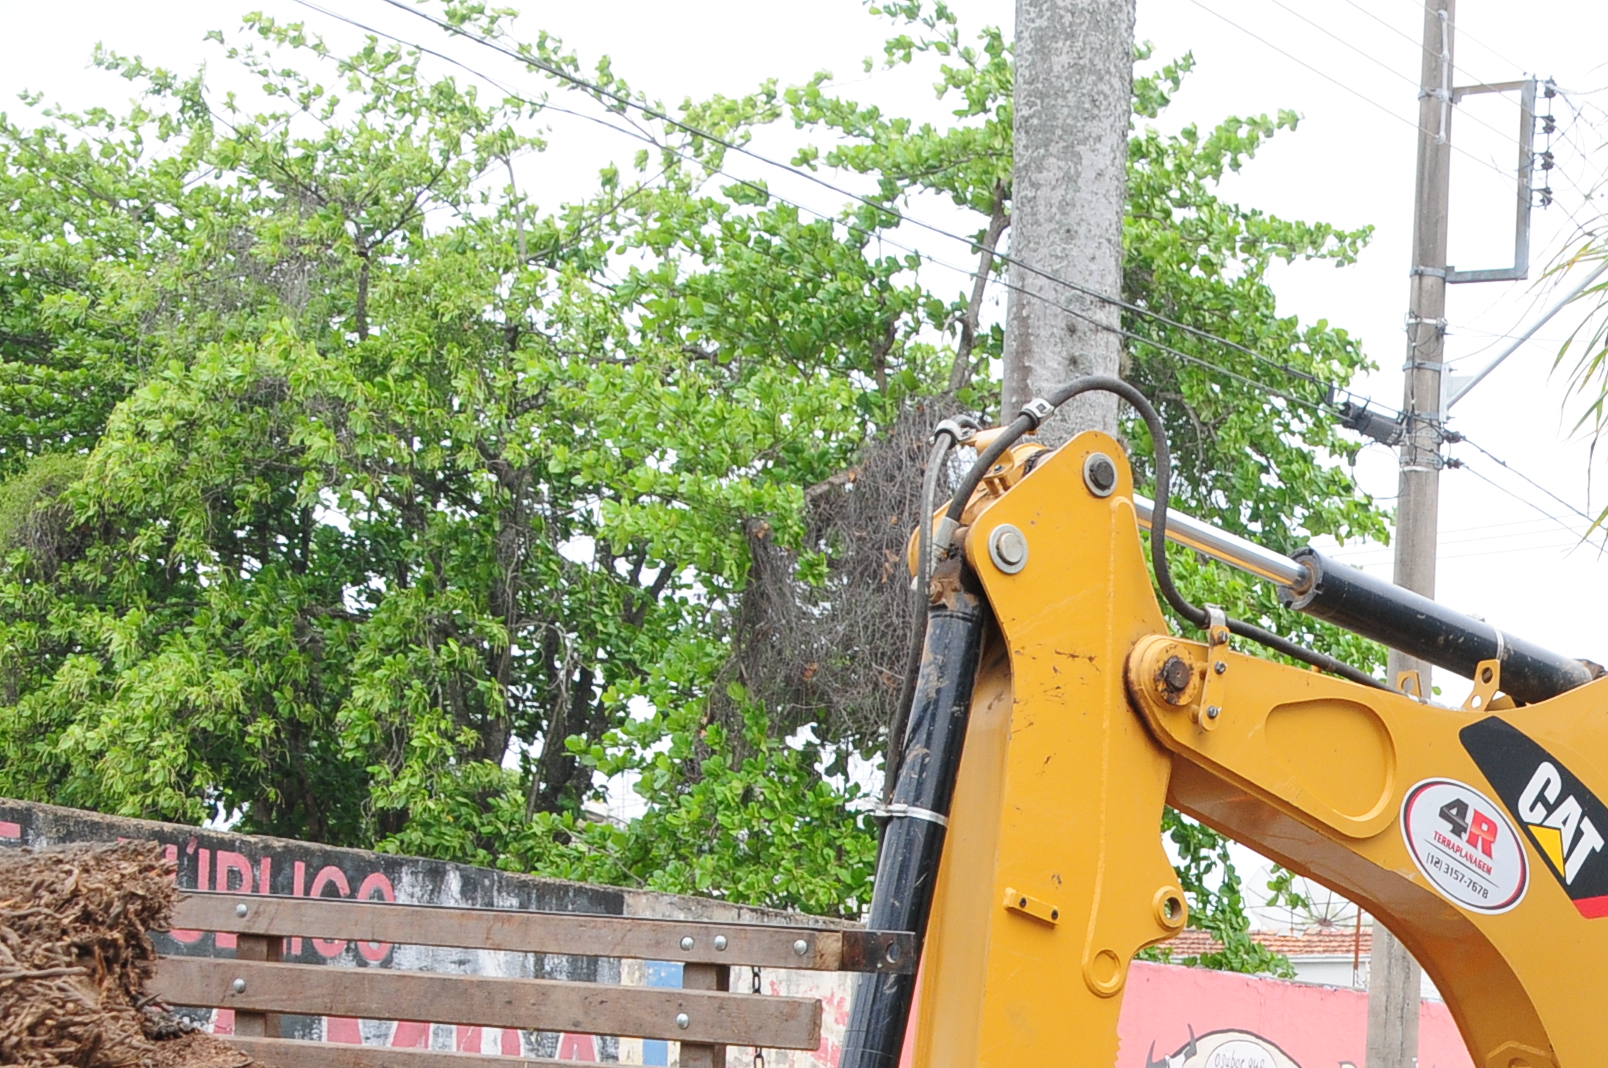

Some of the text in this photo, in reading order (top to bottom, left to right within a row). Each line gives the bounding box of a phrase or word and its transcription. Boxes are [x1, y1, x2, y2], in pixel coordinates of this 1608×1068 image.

[1433, 830, 1493, 876] TERRAPLANAGEM
[1438, 797, 1498, 861] 4R
[1518, 761, 1605, 886] CAT
[117, 837, 395, 963] ÚBLICO
[1426, 851, 1490, 899] (12) 3157-7678
